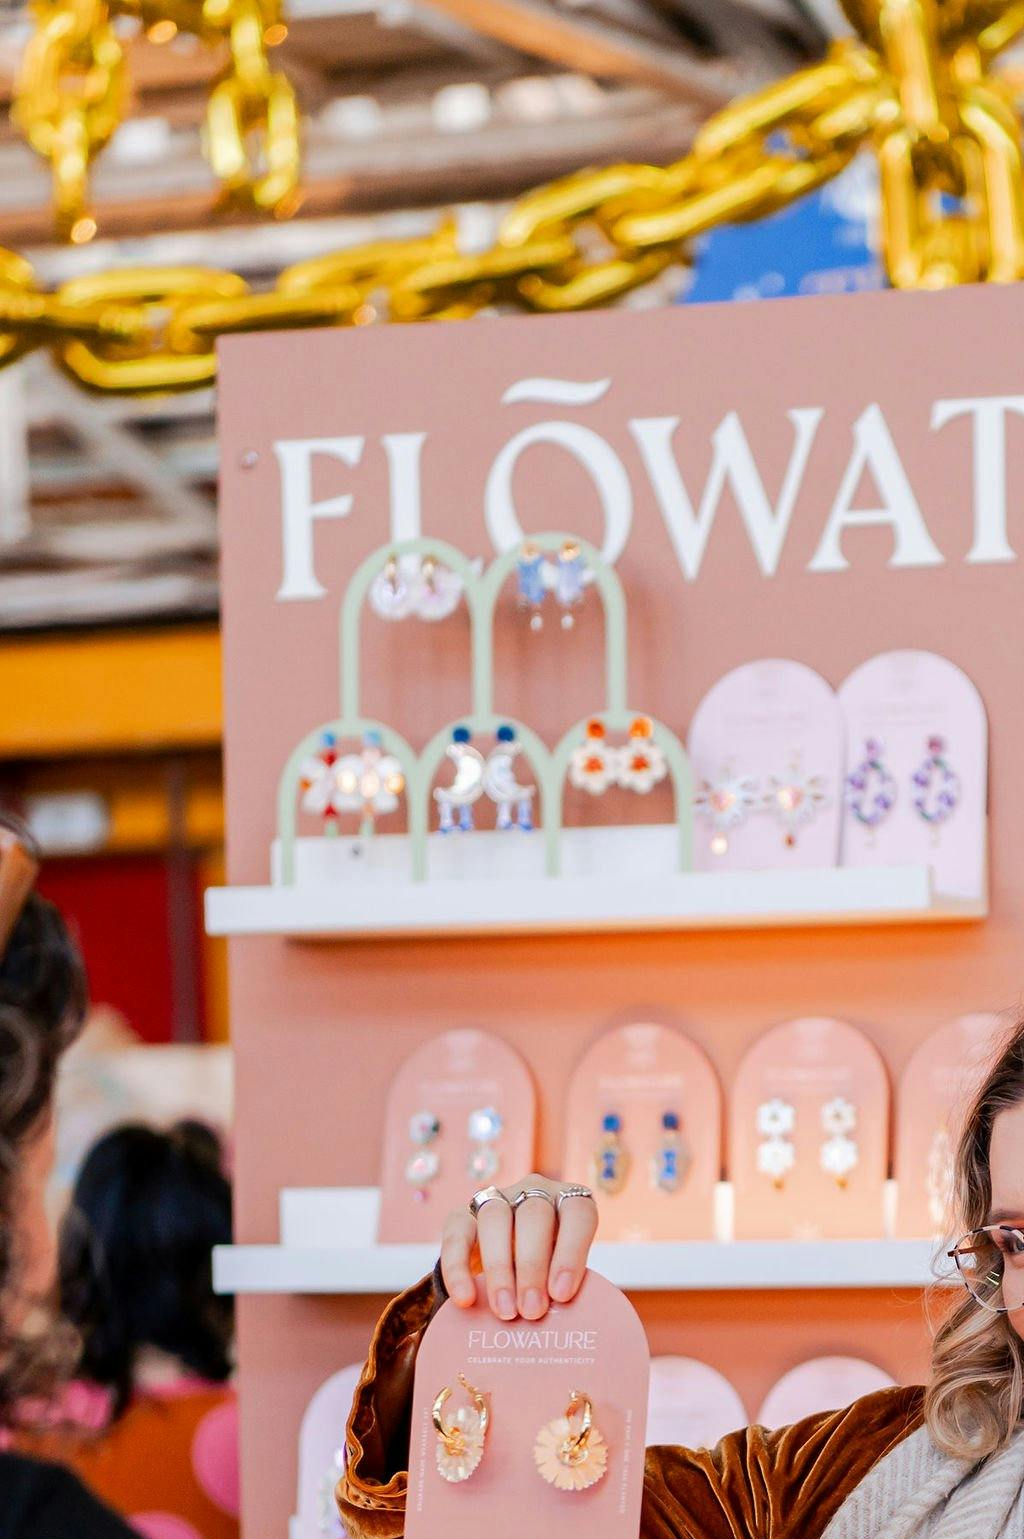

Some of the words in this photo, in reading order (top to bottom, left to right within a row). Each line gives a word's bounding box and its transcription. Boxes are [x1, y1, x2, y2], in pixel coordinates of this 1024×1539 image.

[468, 1330, 597, 1350] FLOWATURE
[467, 1356, 512, 1365] CELEBRATE
[538, 1357, 595, 1365] AUTHENTICITY
